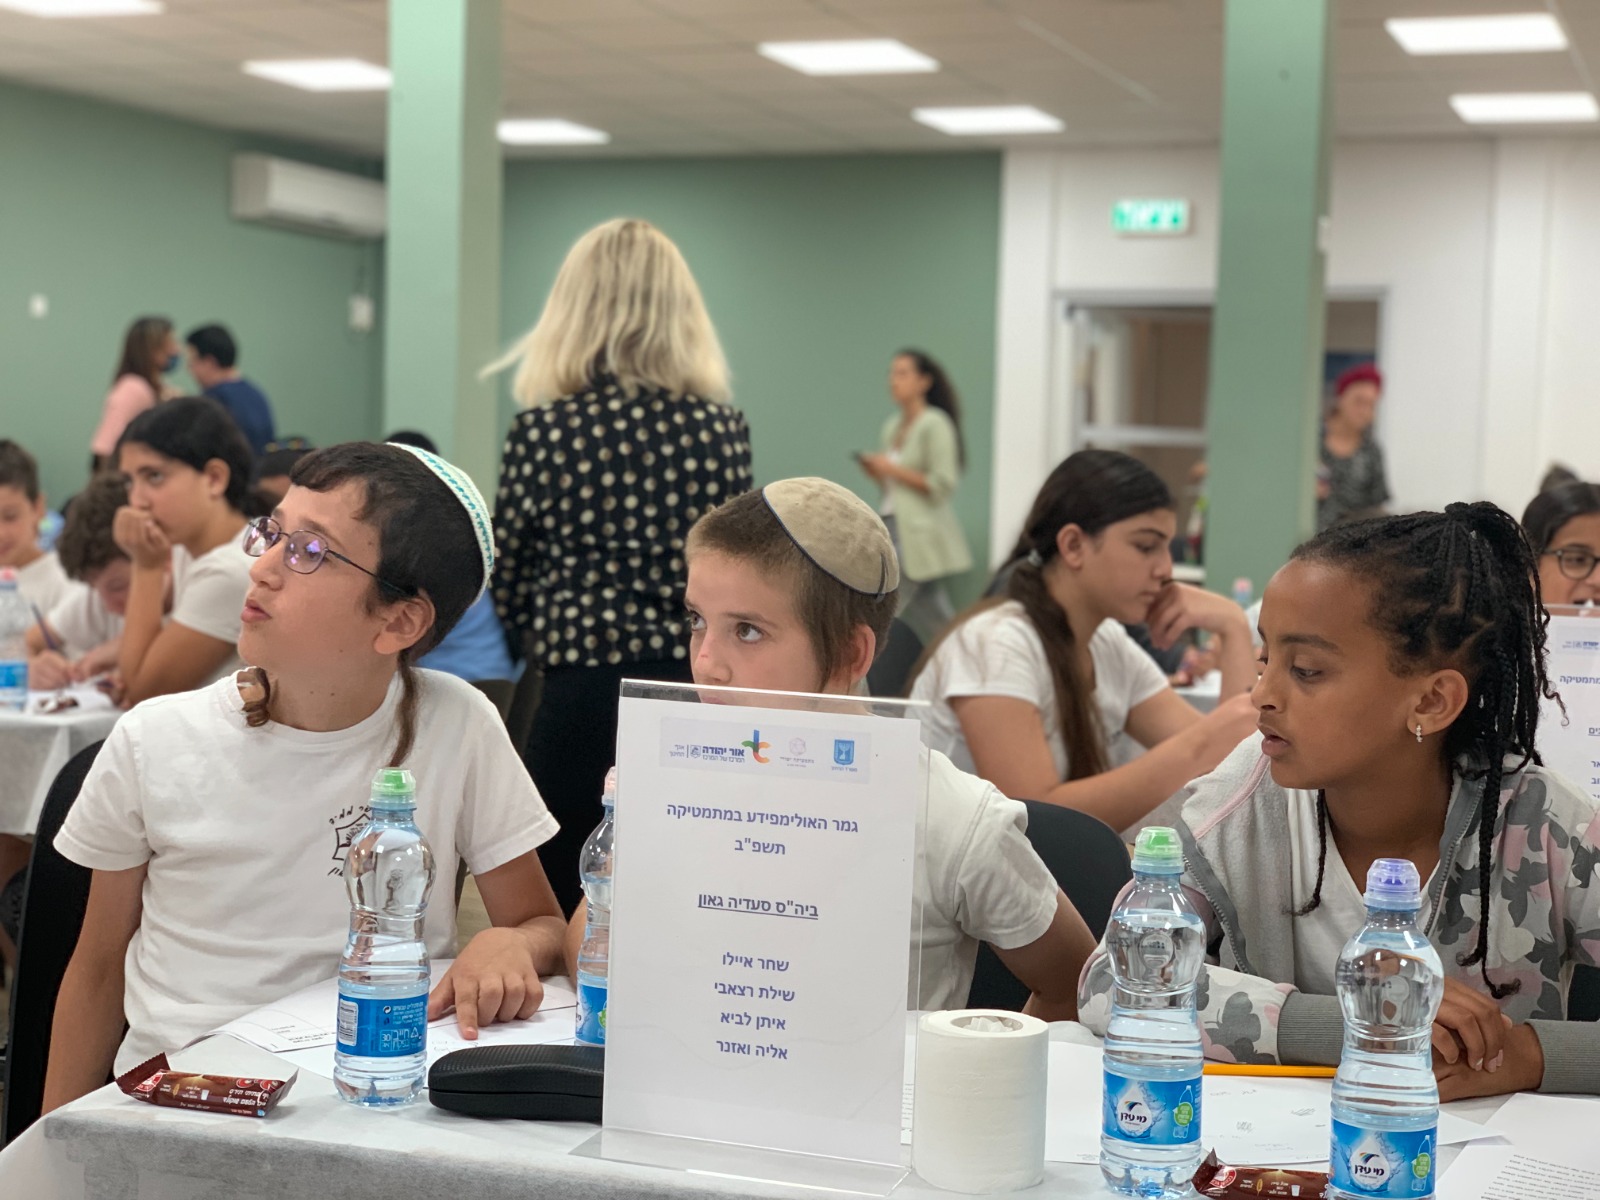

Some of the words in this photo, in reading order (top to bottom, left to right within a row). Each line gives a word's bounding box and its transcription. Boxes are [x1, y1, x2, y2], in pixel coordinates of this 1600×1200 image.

[702, 746, 727, 755] יהודה
[729, 747, 745, 757] אור
[667, 804, 743, 822] במתמטיקה
[747, 812, 828, 830] האולימפידע
[832, 819, 859, 833] גמר
[735, 838, 786, 855] תשפ"ב
[698, 894, 724, 908] גאון
[728, 897, 771, 911] סעדיה
[775, 900, 818, 917] ביה"ס
[723, 952, 753, 968] איילו
[757, 958, 789, 972] שחר
[715, 982, 753, 997] רצאבי
[758, 986, 795, 1001] שילת
[721, 1012, 752, 1026] לביא
[756, 1016, 785, 1030] איתן
[716, 1041, 750, 1055] ואזנר
[756, 1044, 787, 1059] אליה
[1120, 1112, 1136, 1122] עדן
[1136, 1115, 1147, 1123] מי
[1354, 1164, 1372, 1175] עדן
[1373, 1167, 1385, 1177] מי
